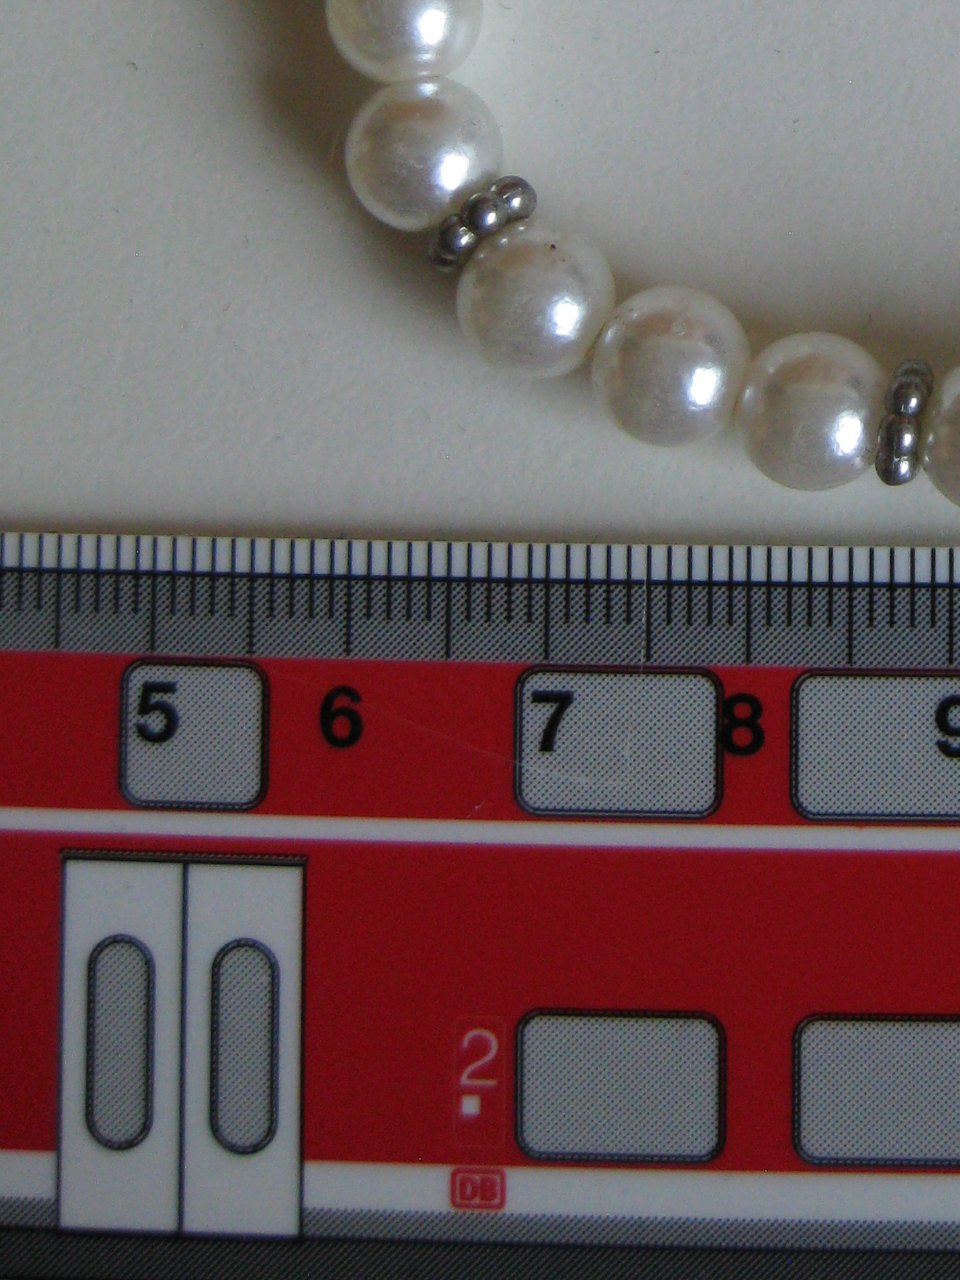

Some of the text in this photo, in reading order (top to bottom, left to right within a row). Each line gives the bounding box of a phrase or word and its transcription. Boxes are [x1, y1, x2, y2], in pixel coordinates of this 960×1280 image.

[135, 681, 180, 743] 5
[320, 686, 364, 747] 6
[531, 690, 575, 752] 7
[722, 694, 765, 755] 8
[457, 1176, 501, 1203] DB
